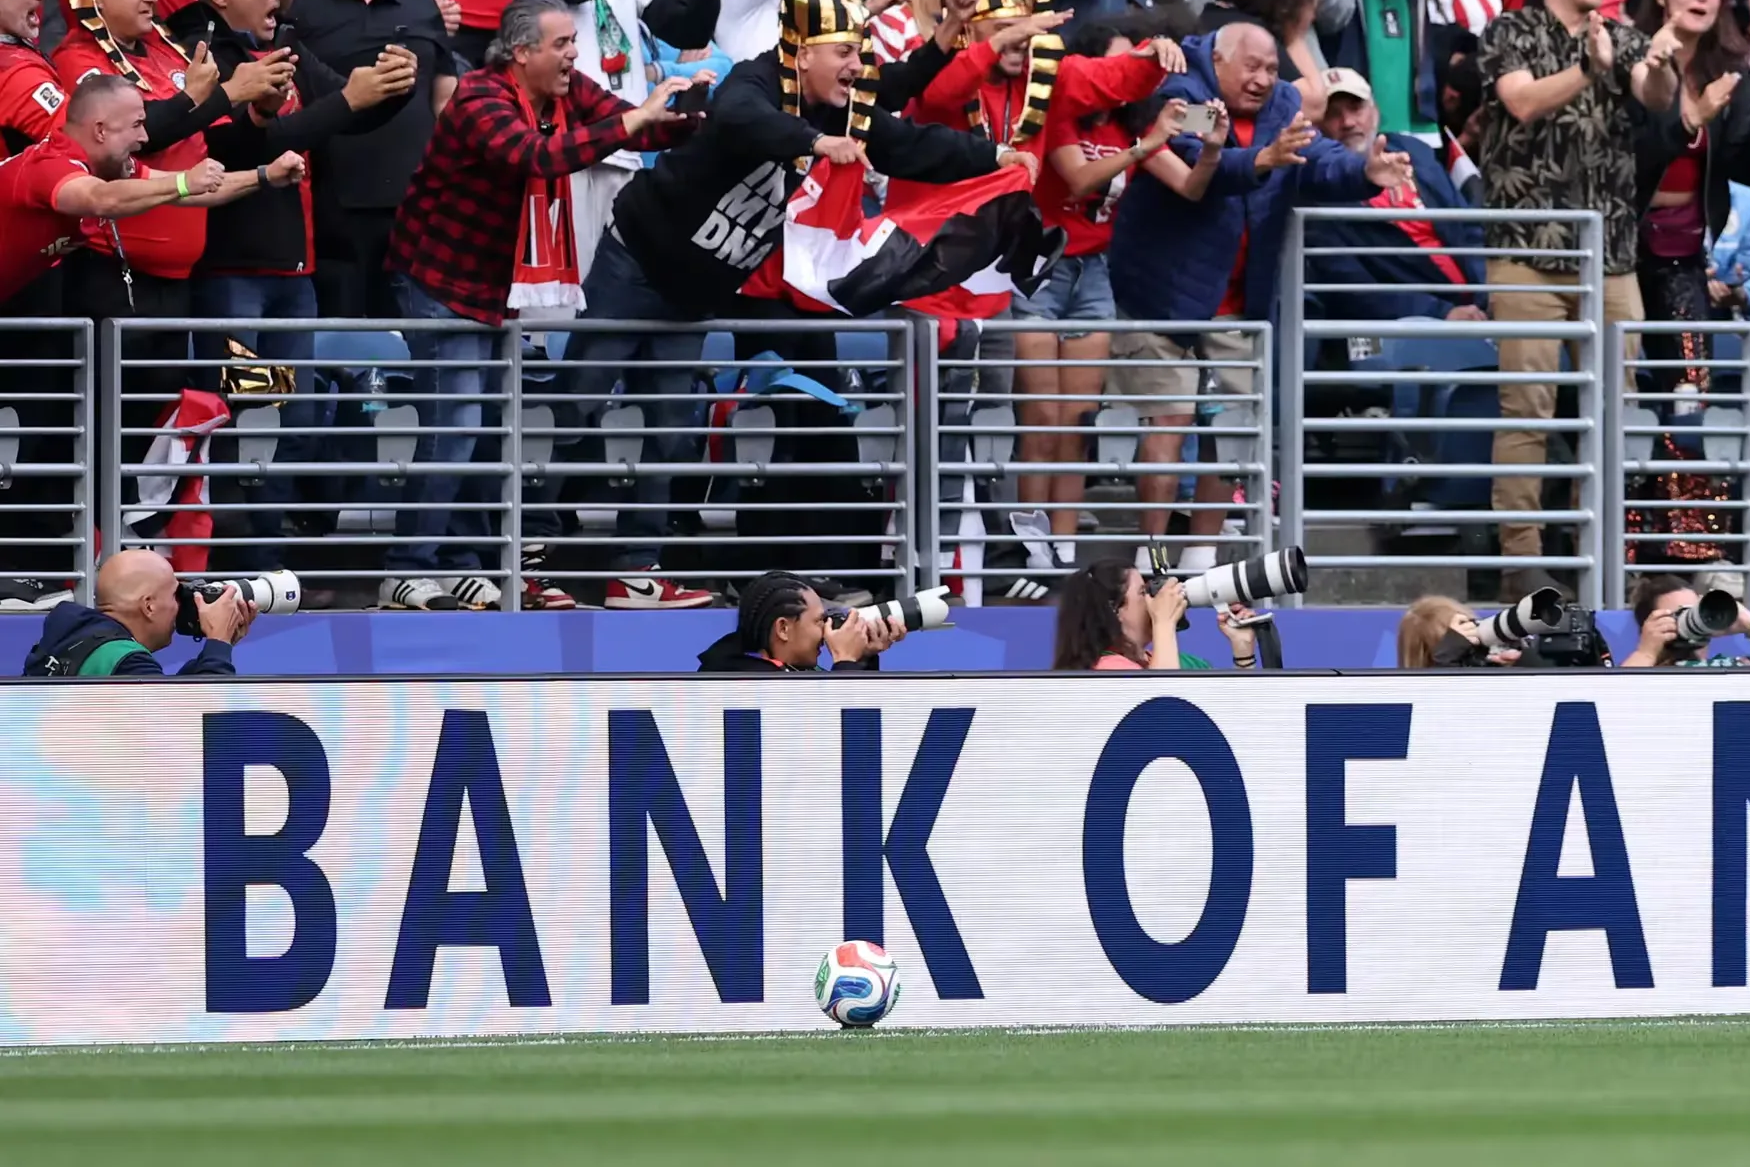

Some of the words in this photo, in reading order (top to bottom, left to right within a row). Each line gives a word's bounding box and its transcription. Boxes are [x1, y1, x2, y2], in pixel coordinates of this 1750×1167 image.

[715, 182, 787, 239] MY
[742, 160, 786, 207] IN
[690, 209, 773, 271] DNA
[202, 707, 985, 1013] BANK
[1082, 695, 1413, 1004] OF
